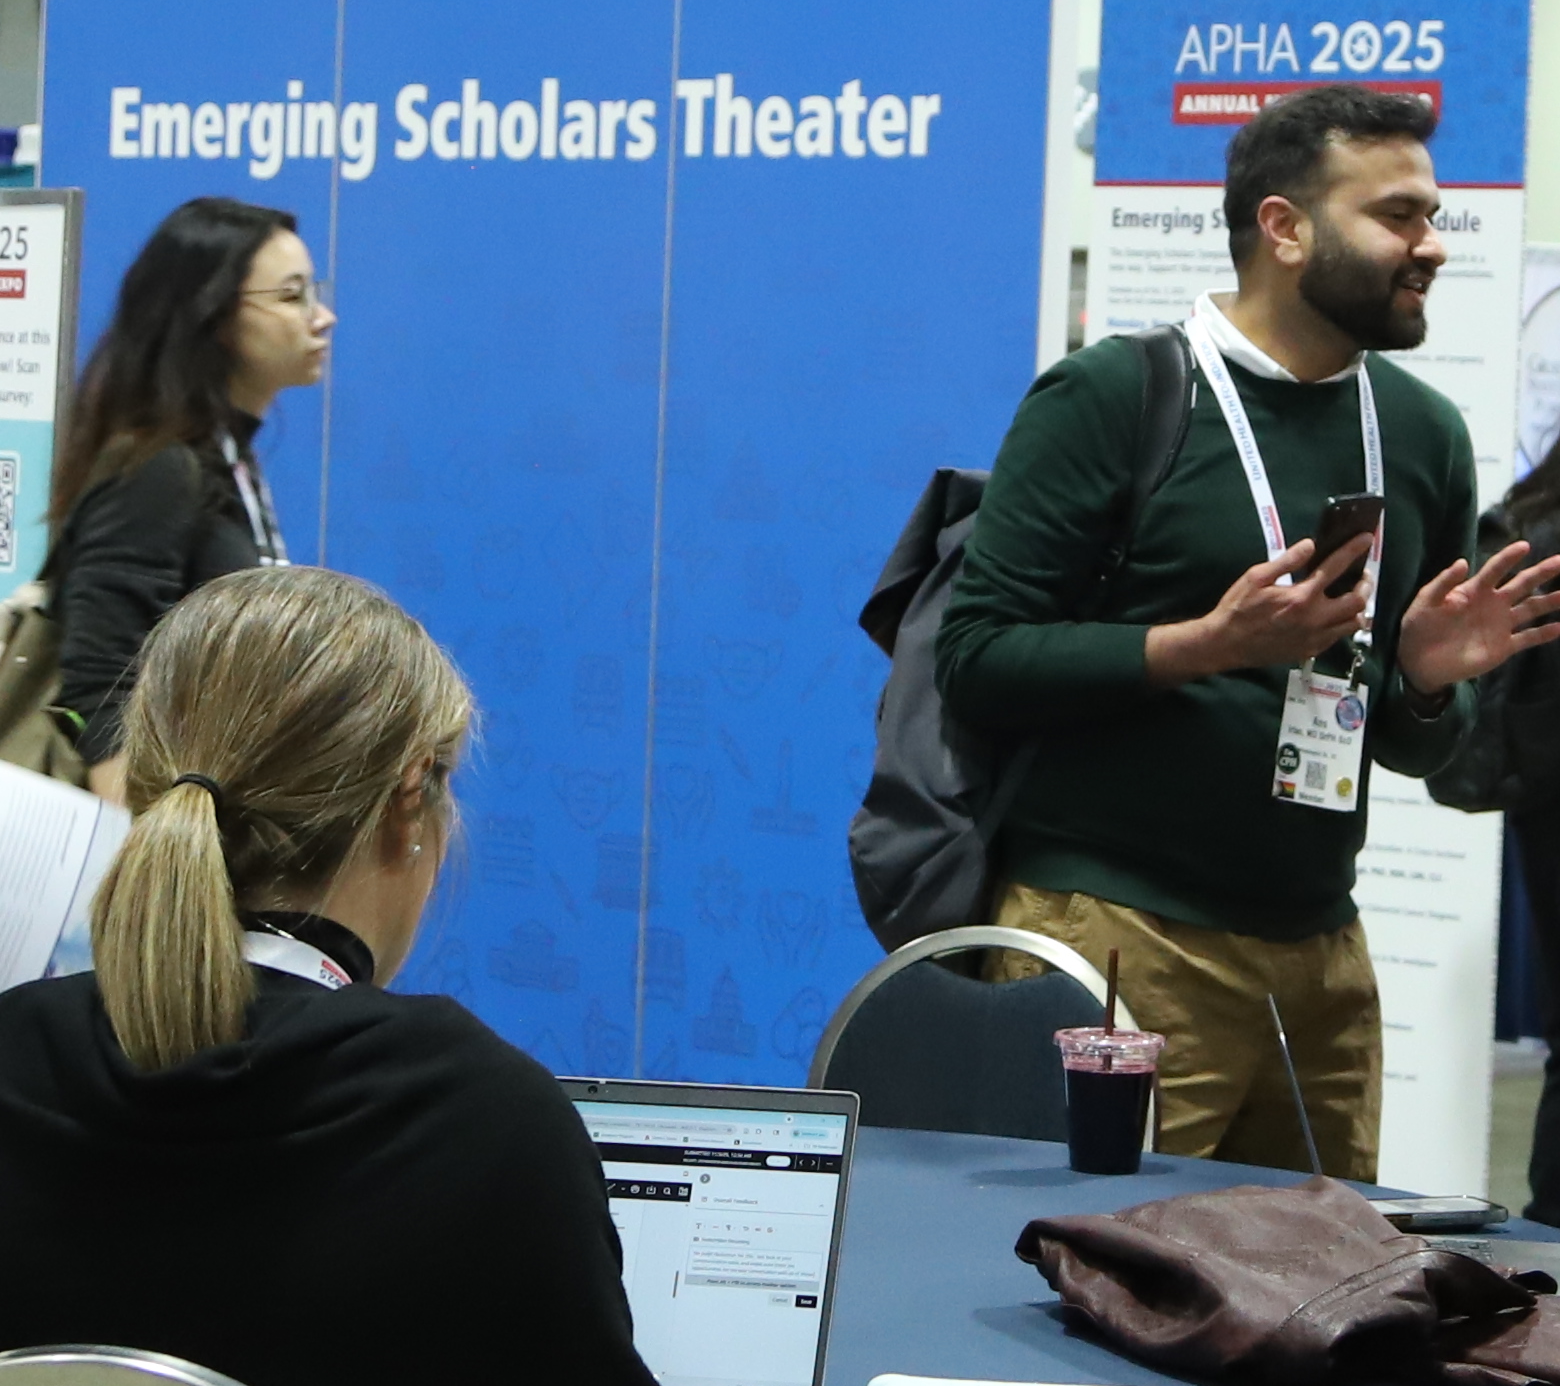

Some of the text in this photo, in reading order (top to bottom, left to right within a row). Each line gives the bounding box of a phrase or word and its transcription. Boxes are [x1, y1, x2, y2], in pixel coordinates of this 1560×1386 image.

[1174, 19, 1445, 74] APHA 2025
[1179, 94, 1260, 114] ANNUAL
[109, 73, 942, 181] Emerging Scholars Theater
[1110, 206, 1205, 235] Emerging
[31, 329, 51, 346] this
[16, 359, 41, 374] Scan
